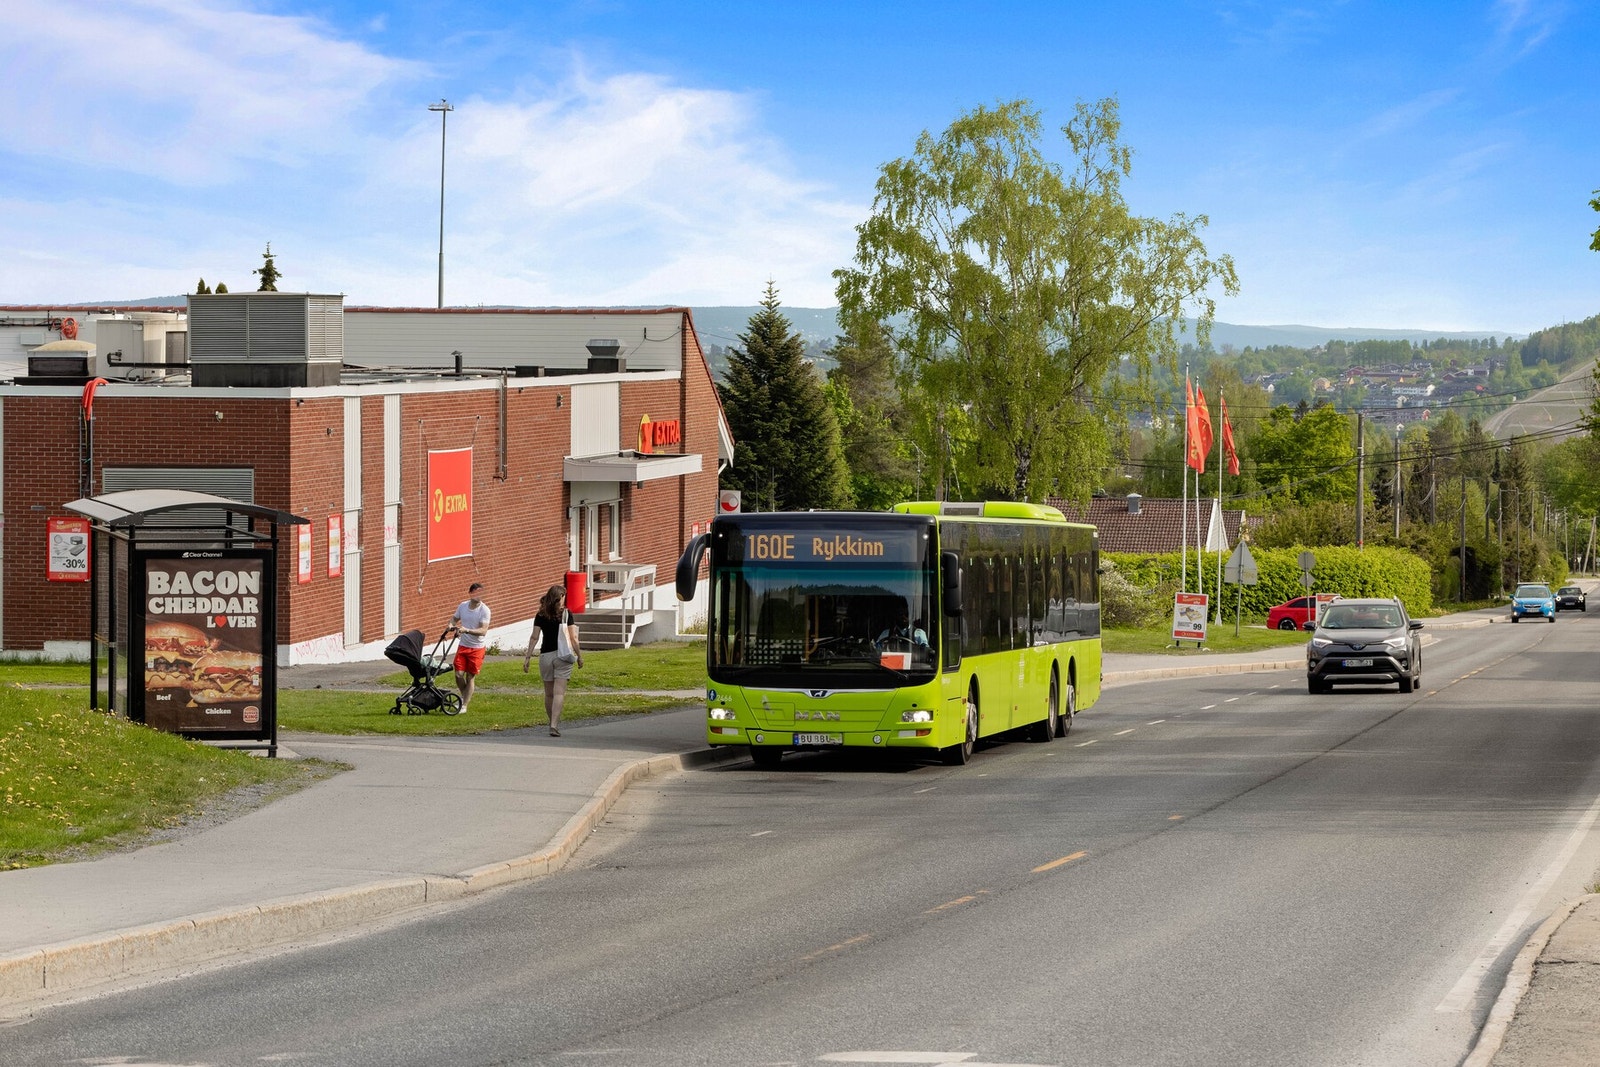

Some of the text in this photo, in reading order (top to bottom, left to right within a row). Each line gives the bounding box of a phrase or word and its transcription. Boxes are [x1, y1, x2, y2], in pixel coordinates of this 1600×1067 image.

[653, 420, 681, 446] EXTRA
[445, 493, 468, 513] EXTRA
[749, 534, 884, 560] 160E Rykkinn
[62, 558, 86, 569] -30%
[147, 570, 261, 595] BACON
[147, 596, 259, 614] CHEDDAR
[156, 693, 172, 701] Beef
[205, 707, 232, 715] Chicken
[795, 711, 841, 720] MAN
